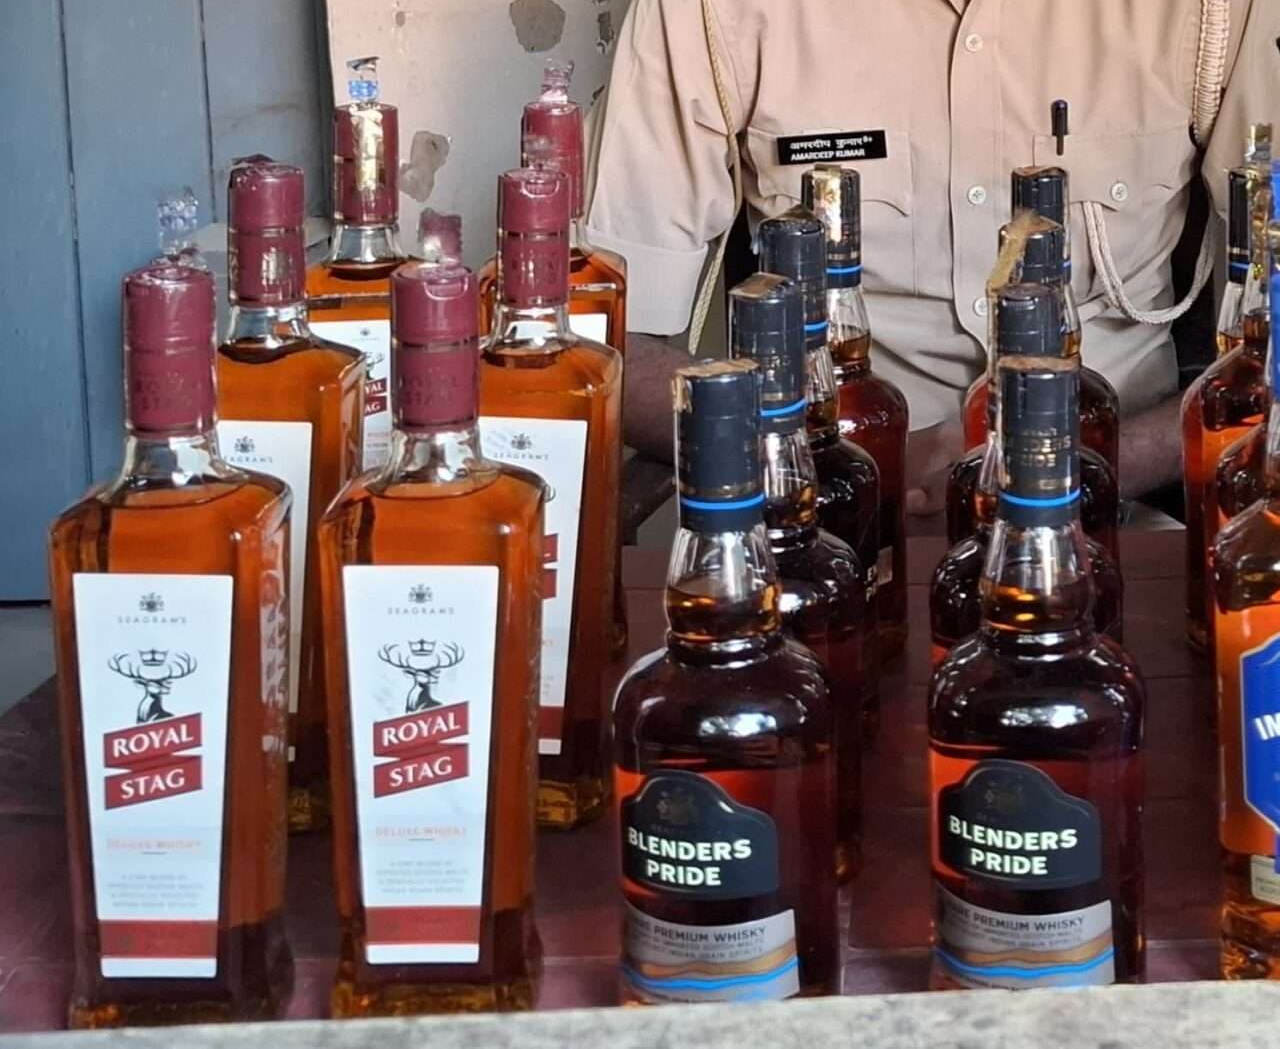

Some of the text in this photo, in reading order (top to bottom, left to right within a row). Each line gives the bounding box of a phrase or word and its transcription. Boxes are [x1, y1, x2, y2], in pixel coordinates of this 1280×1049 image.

[364, 383, 384, 395] YAL
[112, 723, 194, 759] ROYAL
[382, 711, 461, 747] ROYAL
[120, 768, 186, 800] STAG
[389, 755, 453, 788] STAG
[627, 826, 753, 862] BLENDERS
[948, 814, 1079, 851] BLENDERS
[646, 859, 723, 887] PRIDE
[970, 848, 1049, 876] PRIDE
[653, 924, 709, 942] PREMIUM
[713, 925, 766, 942] WHISKY
[972, 913, 1030, 932] PREMIUM
[1033, 915, 1086, 932] WHISKY
